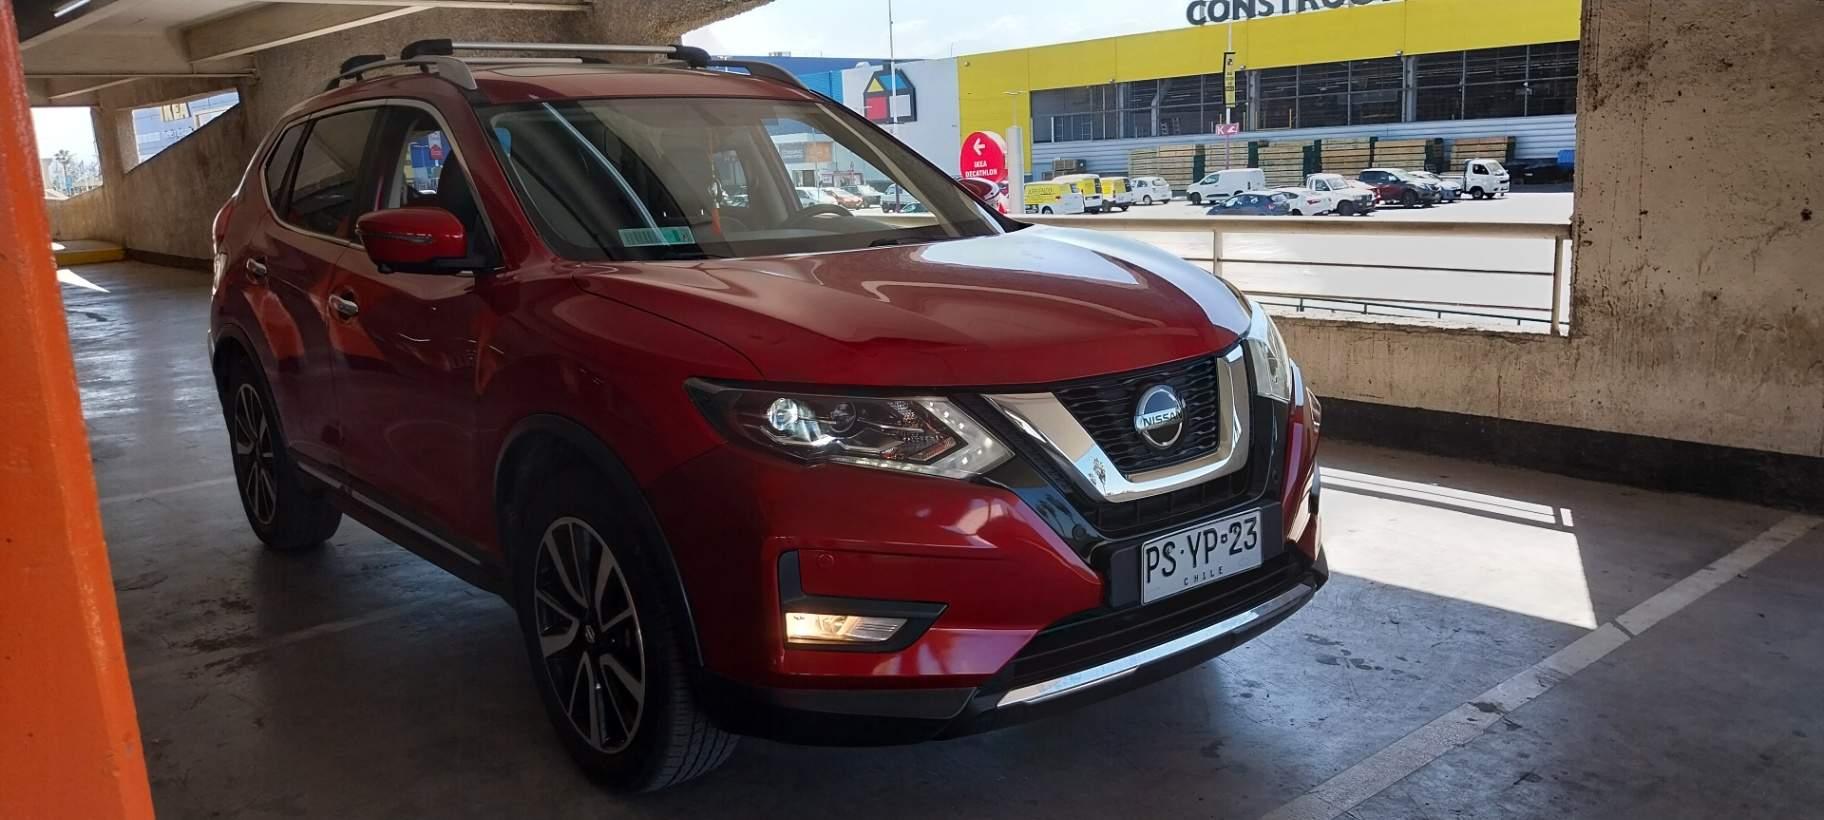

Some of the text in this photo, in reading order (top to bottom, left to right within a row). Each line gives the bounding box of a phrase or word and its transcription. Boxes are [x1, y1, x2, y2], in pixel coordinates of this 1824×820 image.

[974, 160, 987, 168] IKEA
[965, 168, 997, 177] DECATHLON
[1143, 410, 1183, 427] NISSAN
[1184, 566, 1223, 585] CHILE
